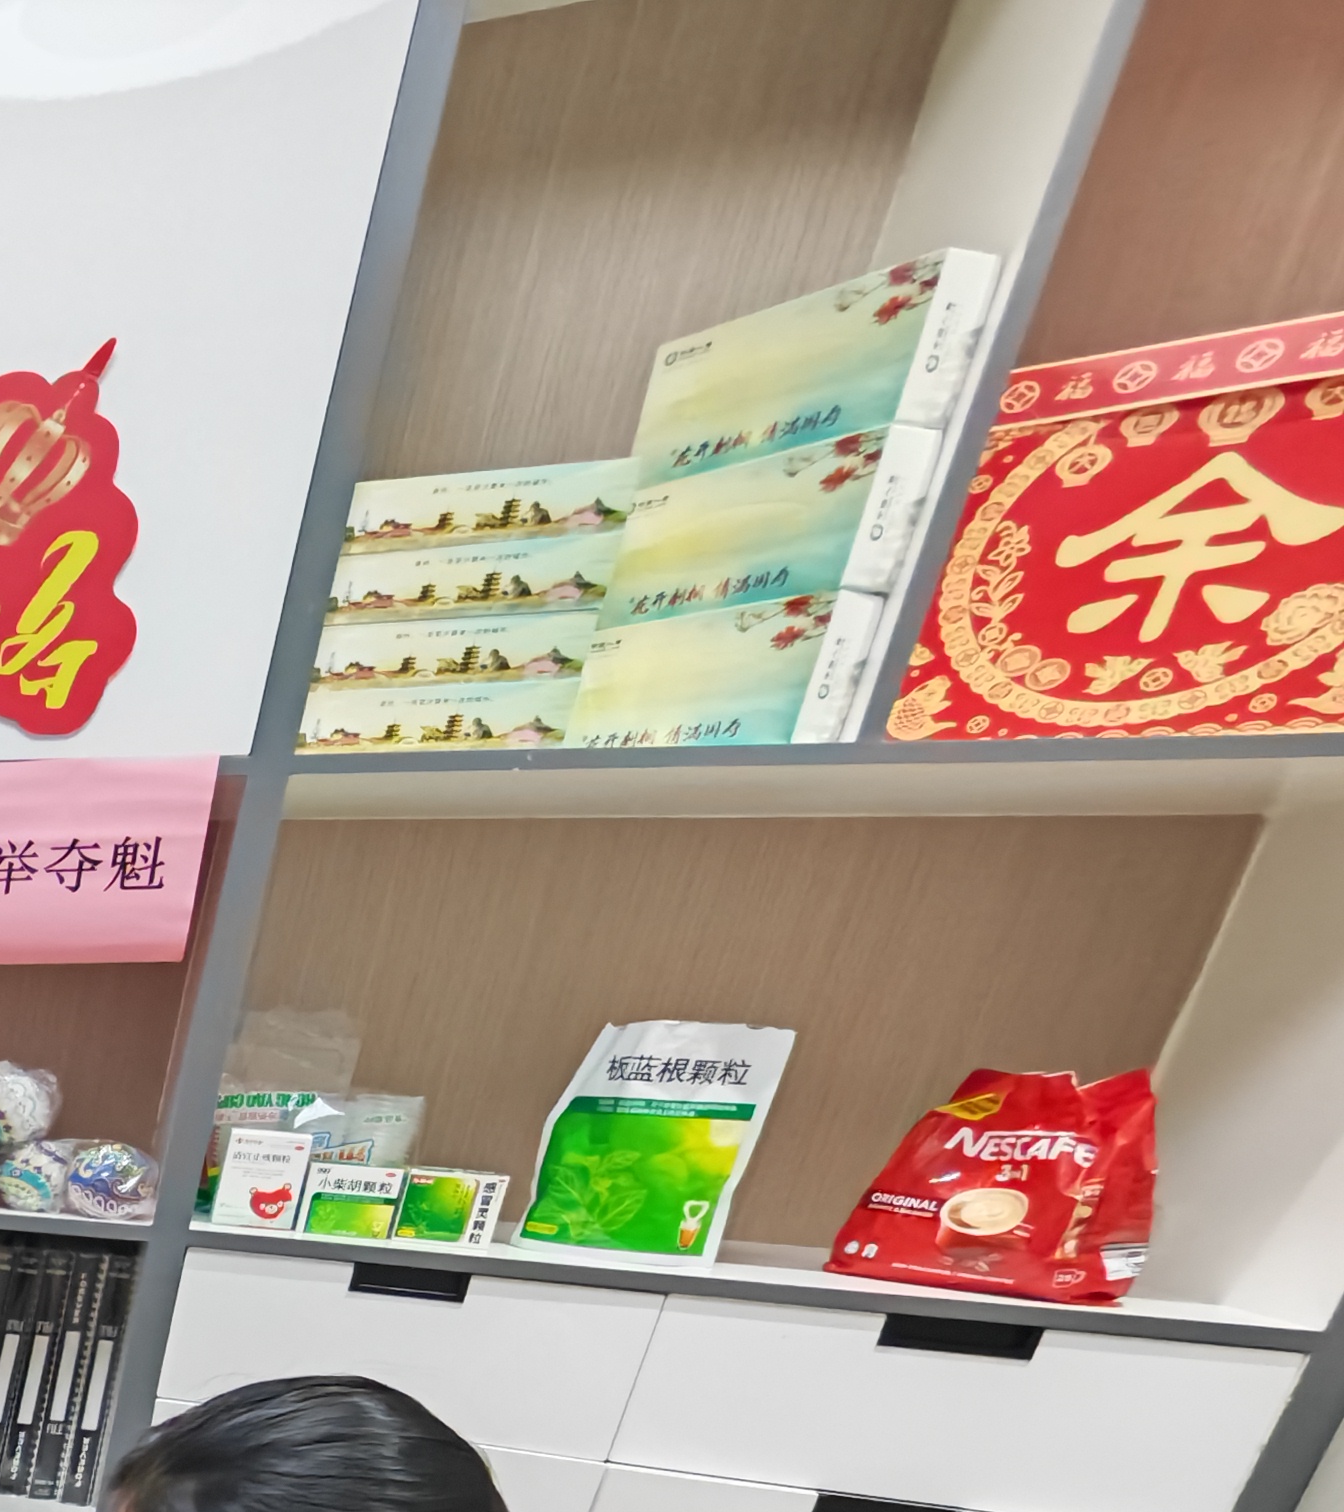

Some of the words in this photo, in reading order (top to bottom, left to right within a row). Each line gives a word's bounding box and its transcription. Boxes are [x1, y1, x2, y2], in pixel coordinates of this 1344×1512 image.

[1054, 451, 1344, 643] 余
[606, 1054, 752, 1086] 板蓝根颗粒
[318, 1175, 394, 1195] 小柴胡颗粒
[870, 1190, 938, 1212] ORIGINAL
